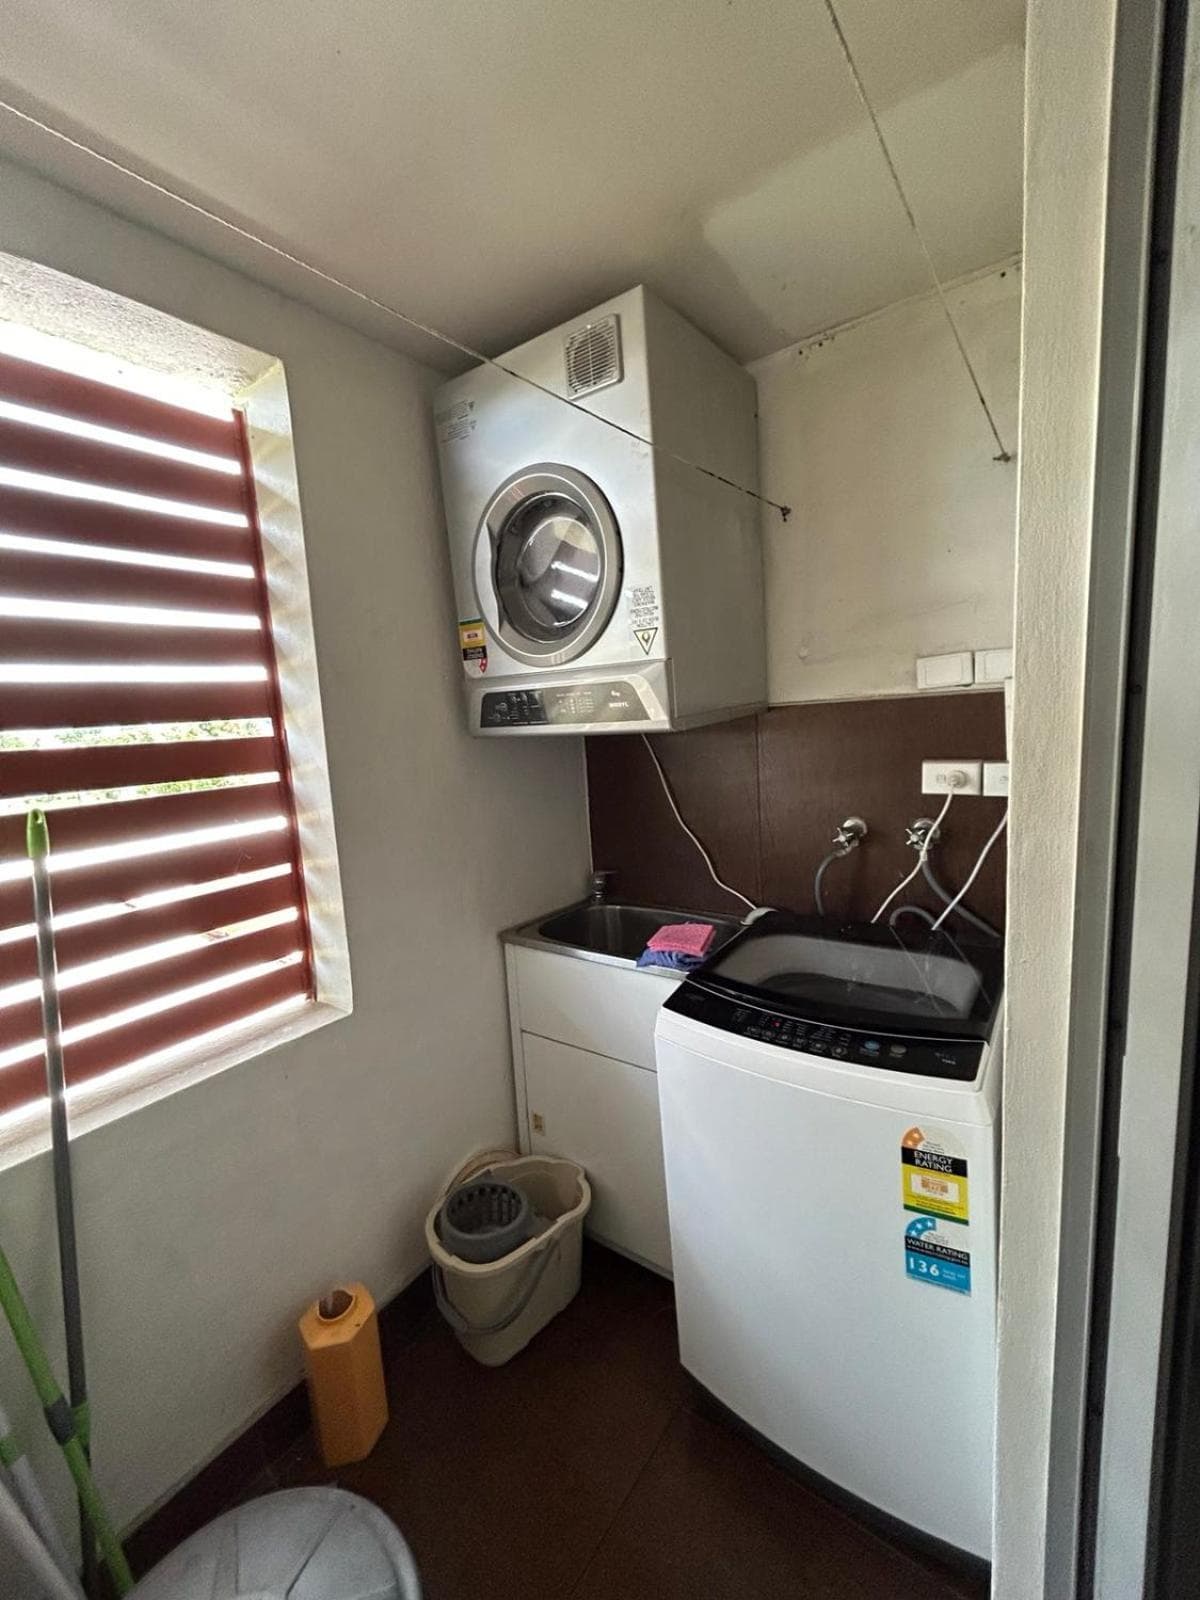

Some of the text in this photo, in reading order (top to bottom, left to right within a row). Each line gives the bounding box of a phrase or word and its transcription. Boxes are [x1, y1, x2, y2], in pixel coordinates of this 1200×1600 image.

[914, 1151, 953, 1165] ENERGY
[915, 1158, 953, 1173] RATING
[907, 1238, 935, 1251] WATER
[936, 1246, 969, 1260] RATING
